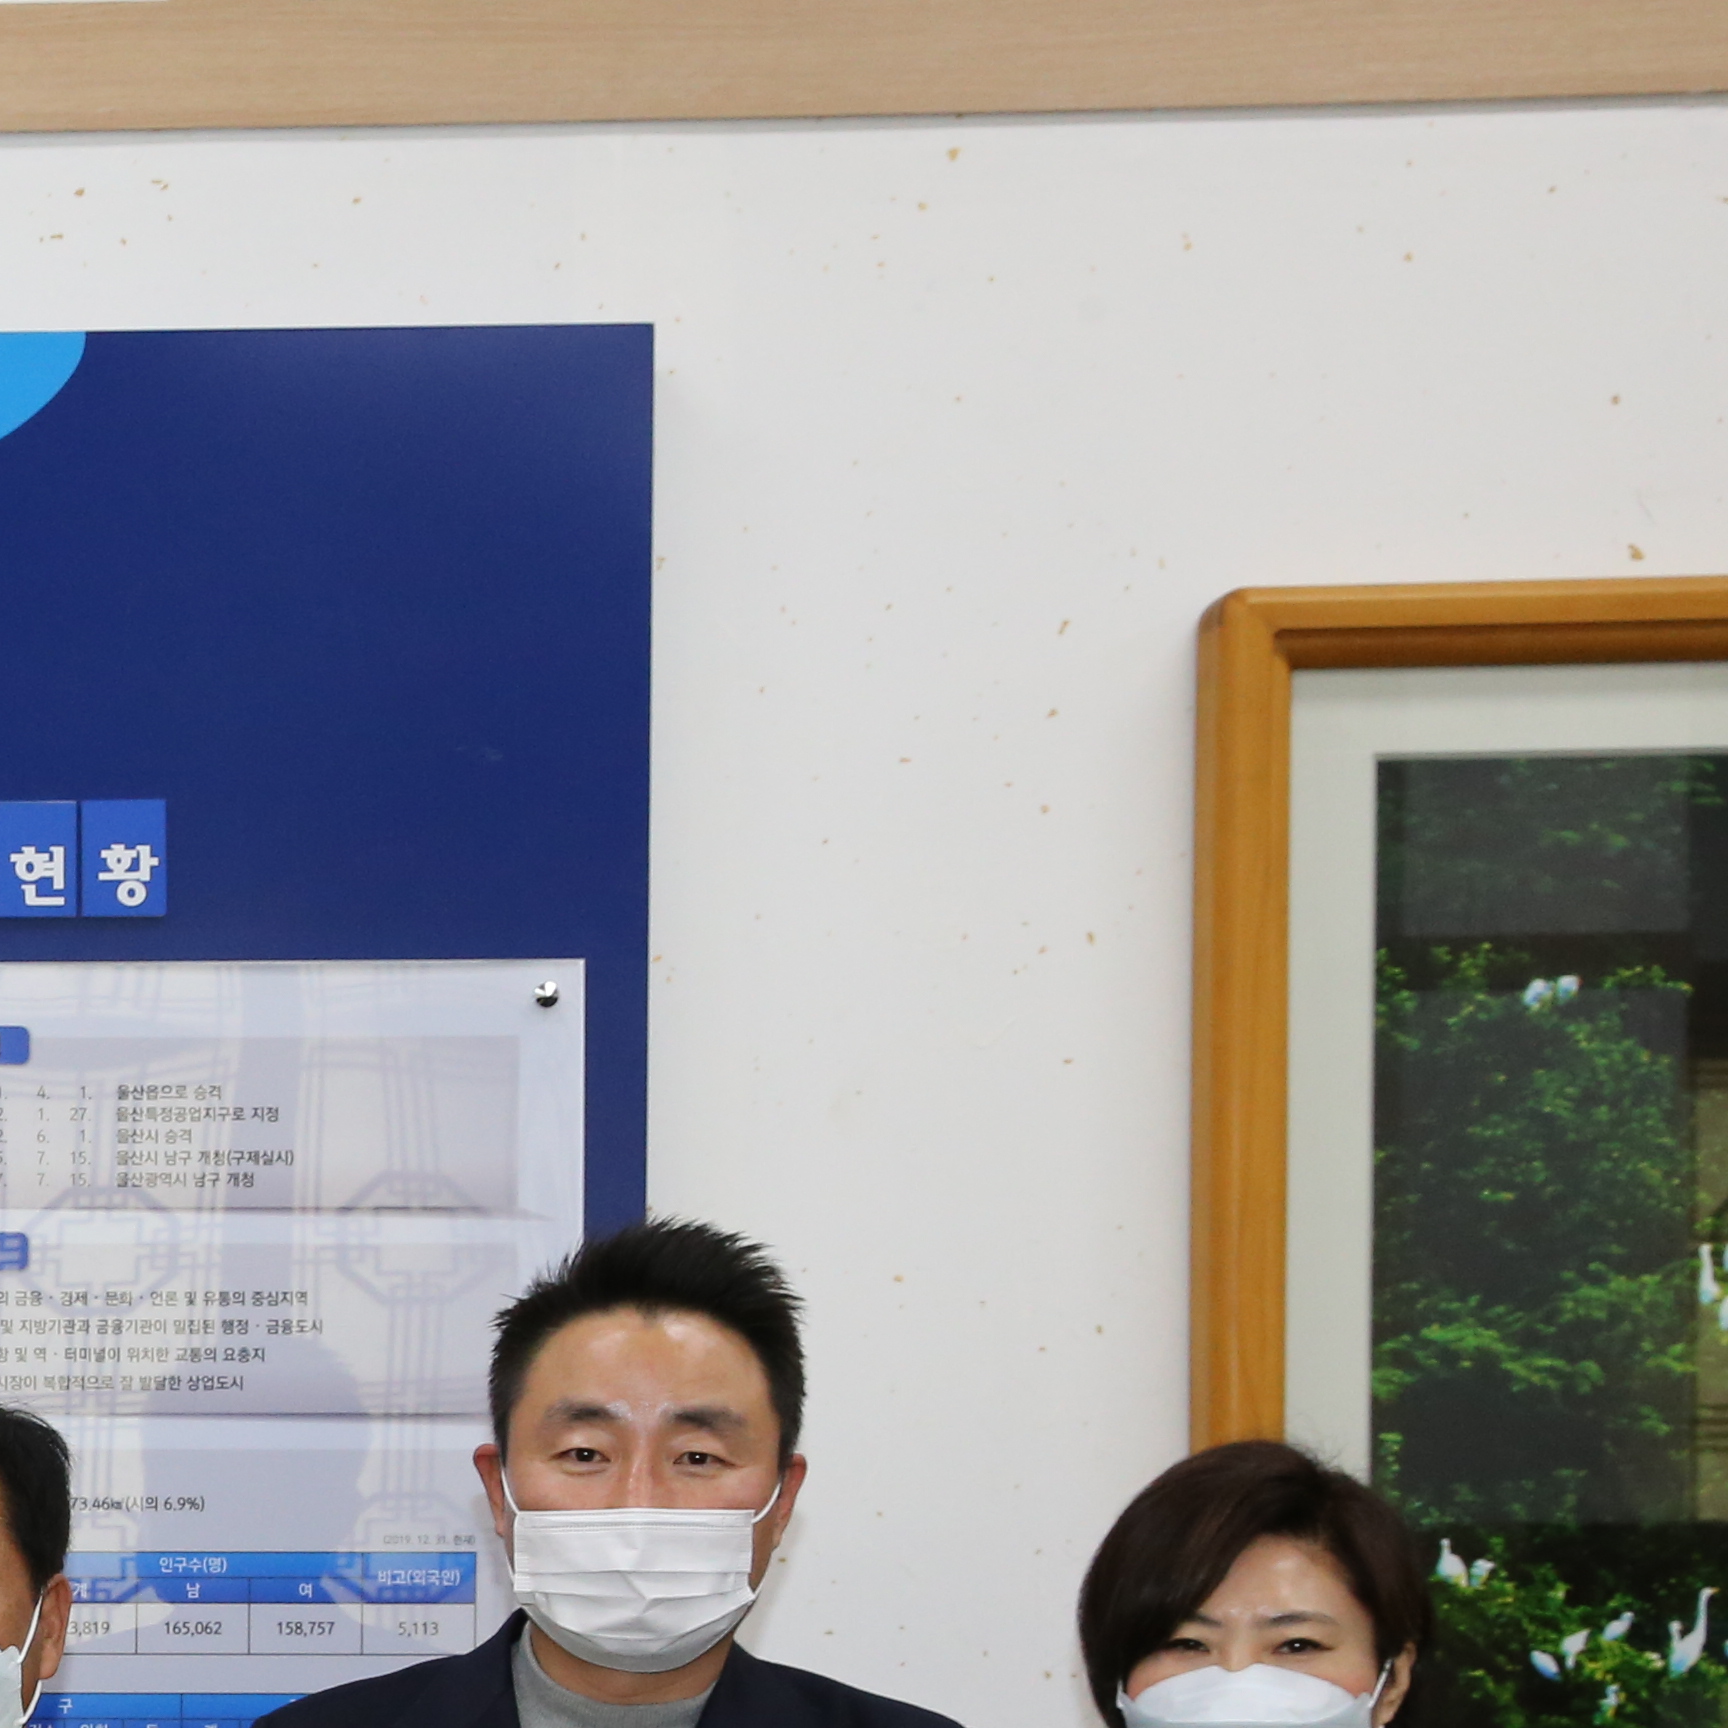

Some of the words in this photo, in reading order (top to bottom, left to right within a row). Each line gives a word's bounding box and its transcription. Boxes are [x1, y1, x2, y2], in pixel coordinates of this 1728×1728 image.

[193, 1085, 222, 1100] 승격
[251, 1107, 279, 1123] 지정
[117, 1129, 158, 1144] 울산시
[164, 1129, 192, 1144] 승격
[117, 1150, 158, 1166] 울산시
[164, 1150, 192, 1166] 남구
[117, 1172, 187, 1189] 울산광역시
[193, 1172, 221, 1189] 남구
[227, 1172, 254, 1189] 개청
[150, 1291, 177, 1307] 언론
[251, 1291, 308, 1307] 중심지역
[19, 1319, 90, 1335] 지방기관과
[96, 1319, 167, 1335] 금융기관이
[221, 1319, 249, 1335] 행정
[266, 1319, 323, 1335] 금융도시
[64, 1347, 121, 1363] 터미널이
[126, 1347, 168, 1363] 위치한
[175, 1347, 217, 1363] 교통의
[223, 1347, 265, 1363] 요충지
[139, 1375, 182, 1392] 발달한
[187, 1375, 244, 1392] 상업도시
[164, 1496, 205, 1513] 6.9%)
[159, 1557, 228, 1573] 인구수(명)
[378, 1569, 460, 1586] 비고(외국인)
[186, 1583, 200, 1598] 남
[298, 1583, 312, 1598] 여
[164, 1622, 223, 1637] 165,062
[277, 1622, 335, 1637] 158,757
[398, 1622, 439, 1637] 5,113
[58, 1699, 73, 1714] 구
